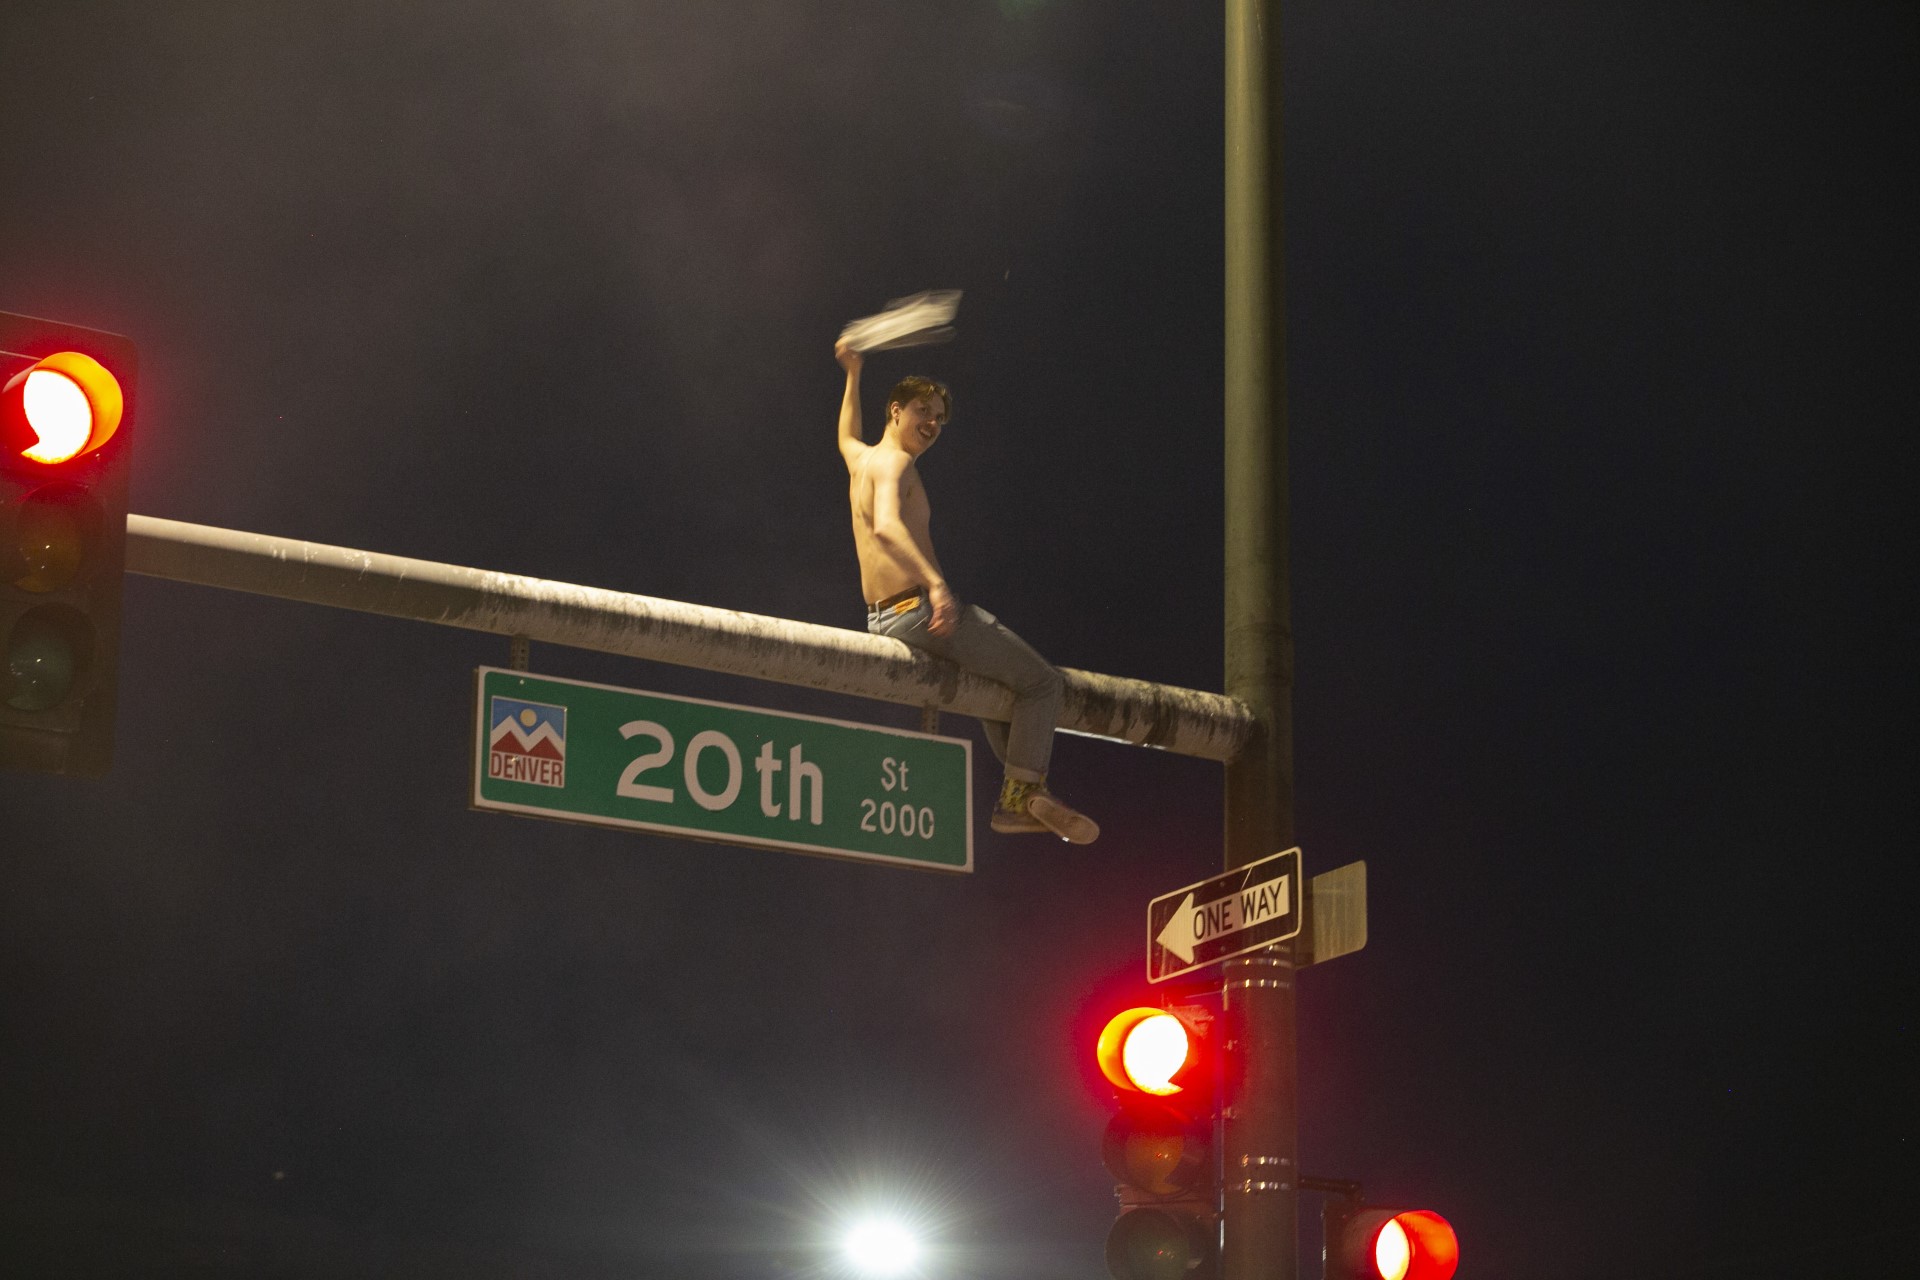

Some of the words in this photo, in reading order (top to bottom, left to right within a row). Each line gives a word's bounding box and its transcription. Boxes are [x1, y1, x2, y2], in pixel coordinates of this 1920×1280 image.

[490, 752, 563, 786] DENVER
[616, 719, 824, 826] 20th
[881, 757, 910, 792] St
[860, 798, 935, 840] 2000
[1193, 901, 1232, 940] ONE
[1240, 882, 1282, 923] WAY
